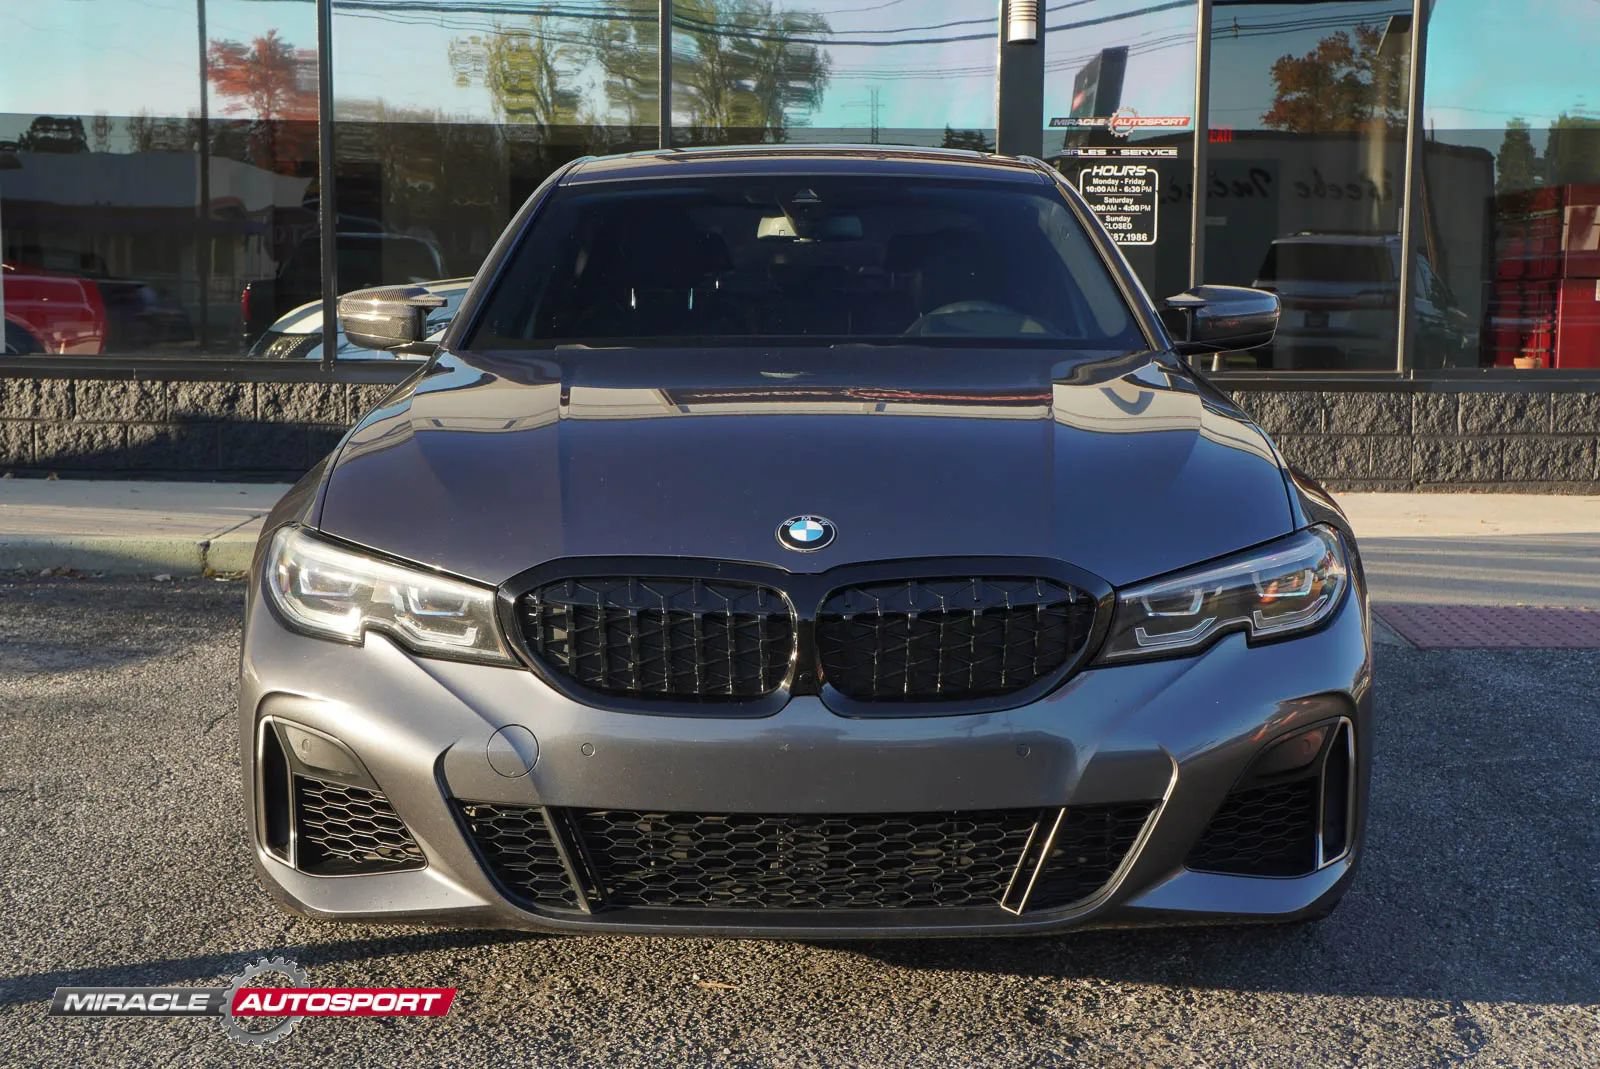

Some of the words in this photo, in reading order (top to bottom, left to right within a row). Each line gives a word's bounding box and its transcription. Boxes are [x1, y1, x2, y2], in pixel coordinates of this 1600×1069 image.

[1053, 118, 1105, 126] MIRACLE
[1114, 118, 1187, 126] AUTOSPORT
[1092, 165, 1147, 176] HOURS
[1092, 178, 1119, 186] Monday
[1124, 178, 1146, 186] Friday
[1103, 197, 1134, 205] Saturday
[1105, 215, 1132, 223] Sunday
[1111, 233, 1148, 241] 87.1986
[784, 515, 830, 526] BMW
